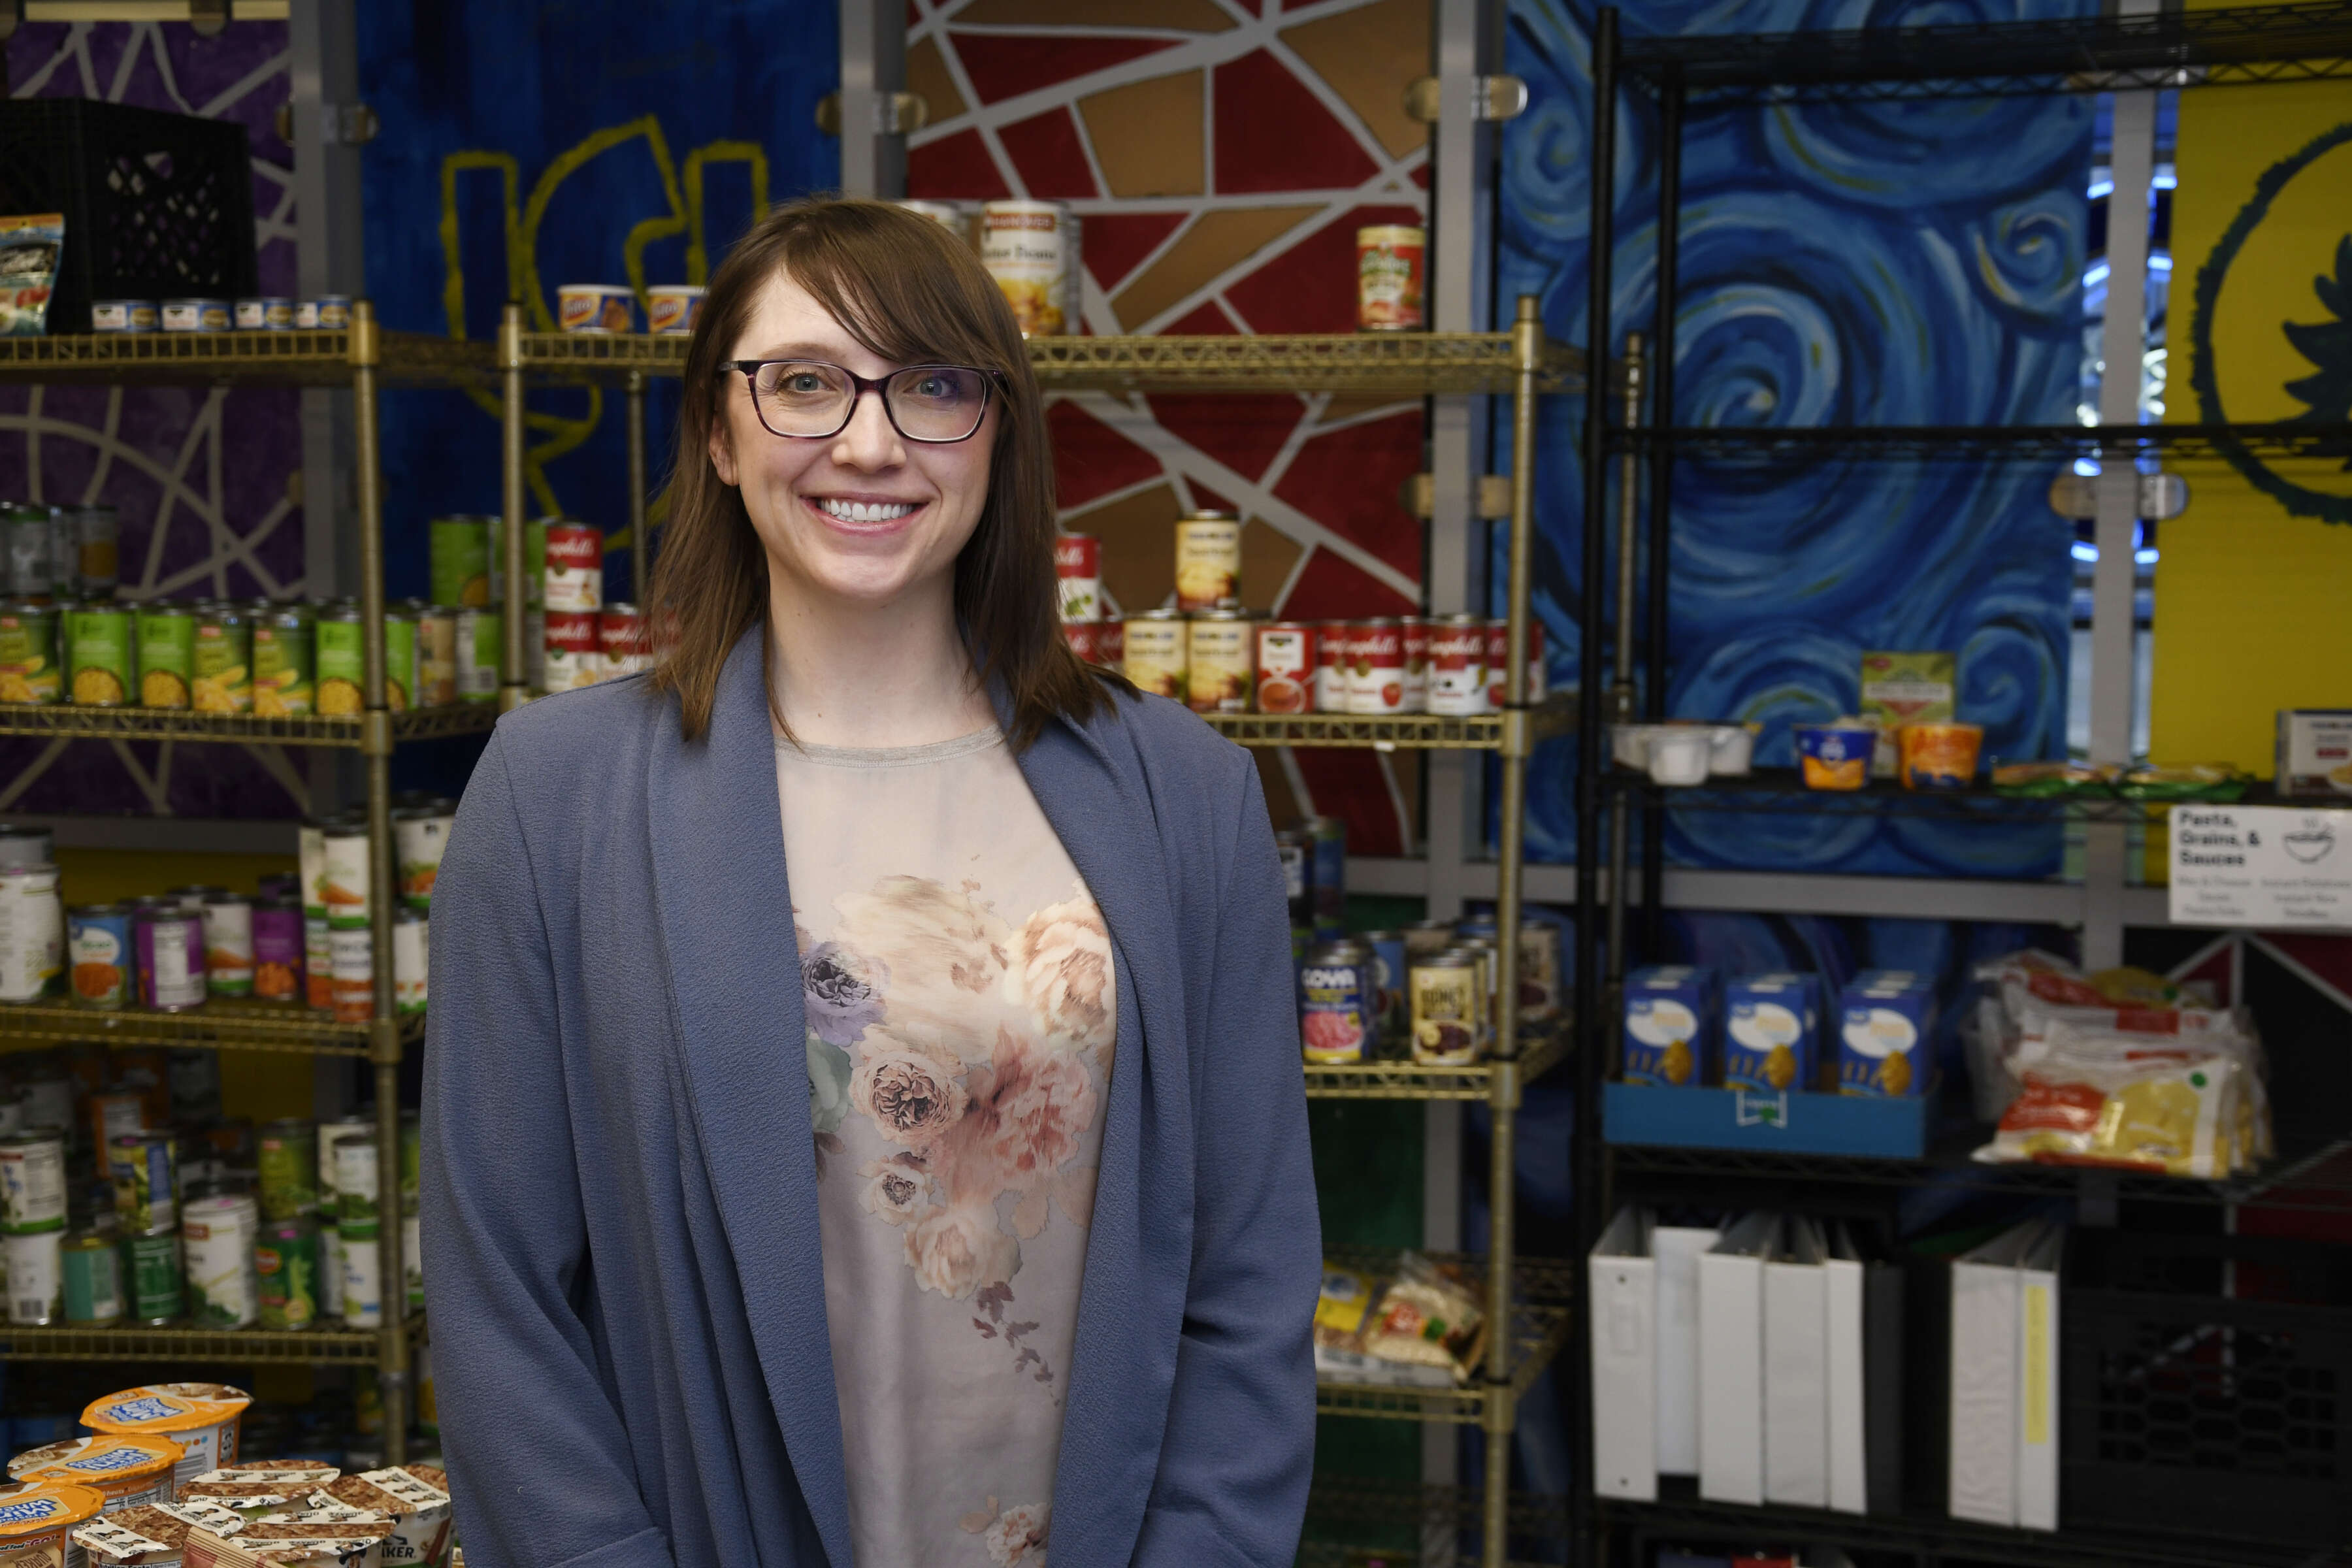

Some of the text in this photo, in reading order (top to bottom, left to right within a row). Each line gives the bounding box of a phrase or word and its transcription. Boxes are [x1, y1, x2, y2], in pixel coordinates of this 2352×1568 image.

[2180, 812, 2236, 828] Pasta,
[2180, 831, 2261, 848] Grains, &
[2180, 851, 2246, 867] Sauces
